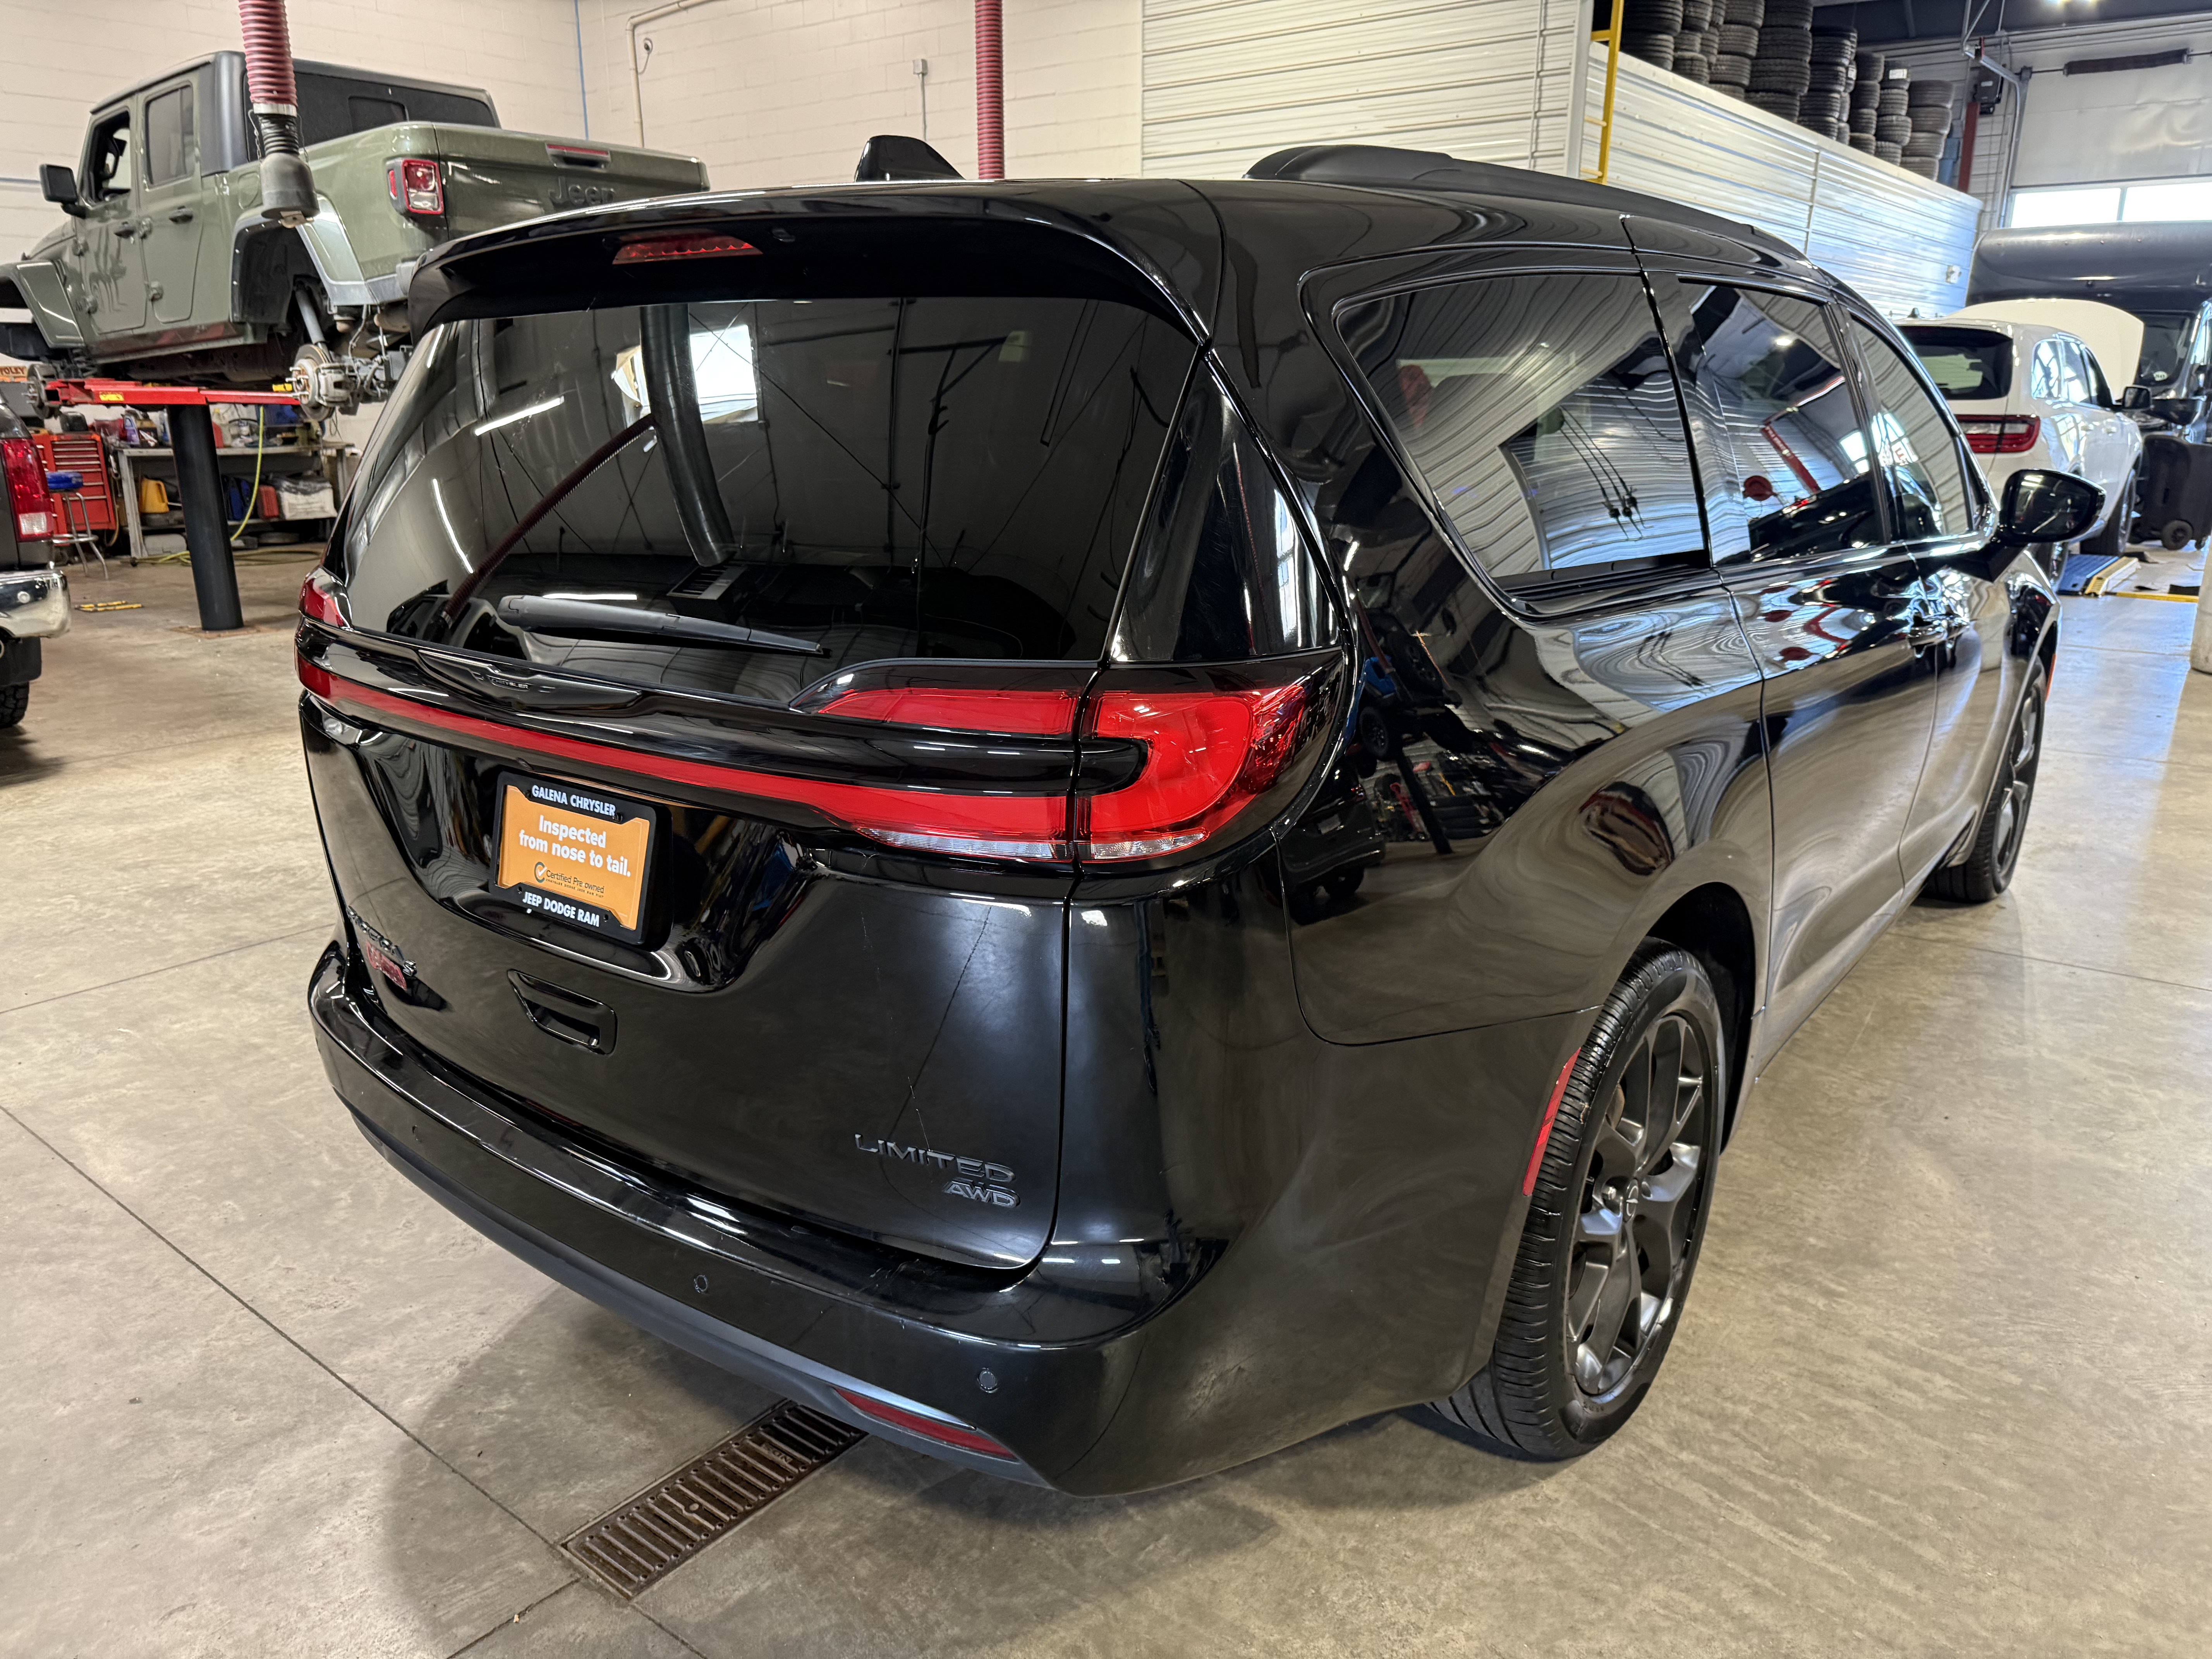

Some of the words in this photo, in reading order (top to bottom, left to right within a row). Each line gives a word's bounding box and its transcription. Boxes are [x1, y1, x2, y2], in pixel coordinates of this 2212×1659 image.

[532, 785, 568, 805] GALENA
[570, 795, 616, 816] CHRYSLER
[539, 815, 606, 848] Inspected
[519, 830, 548, 853] from
[552, 843, 586, 863] nose
[589, 850, 603, 868] to
[606, 855, 631, 877] tail.
[546, 870, 572, 883] Certified
[522, 891, 542, 907] JEEP
[544, 898, 576, 919] DODGE
[577, 909, 599, 927] RAM
[855, 1133, 1016, 1182] LIMITED
[942, 1178, 1020, 1208] AWD
